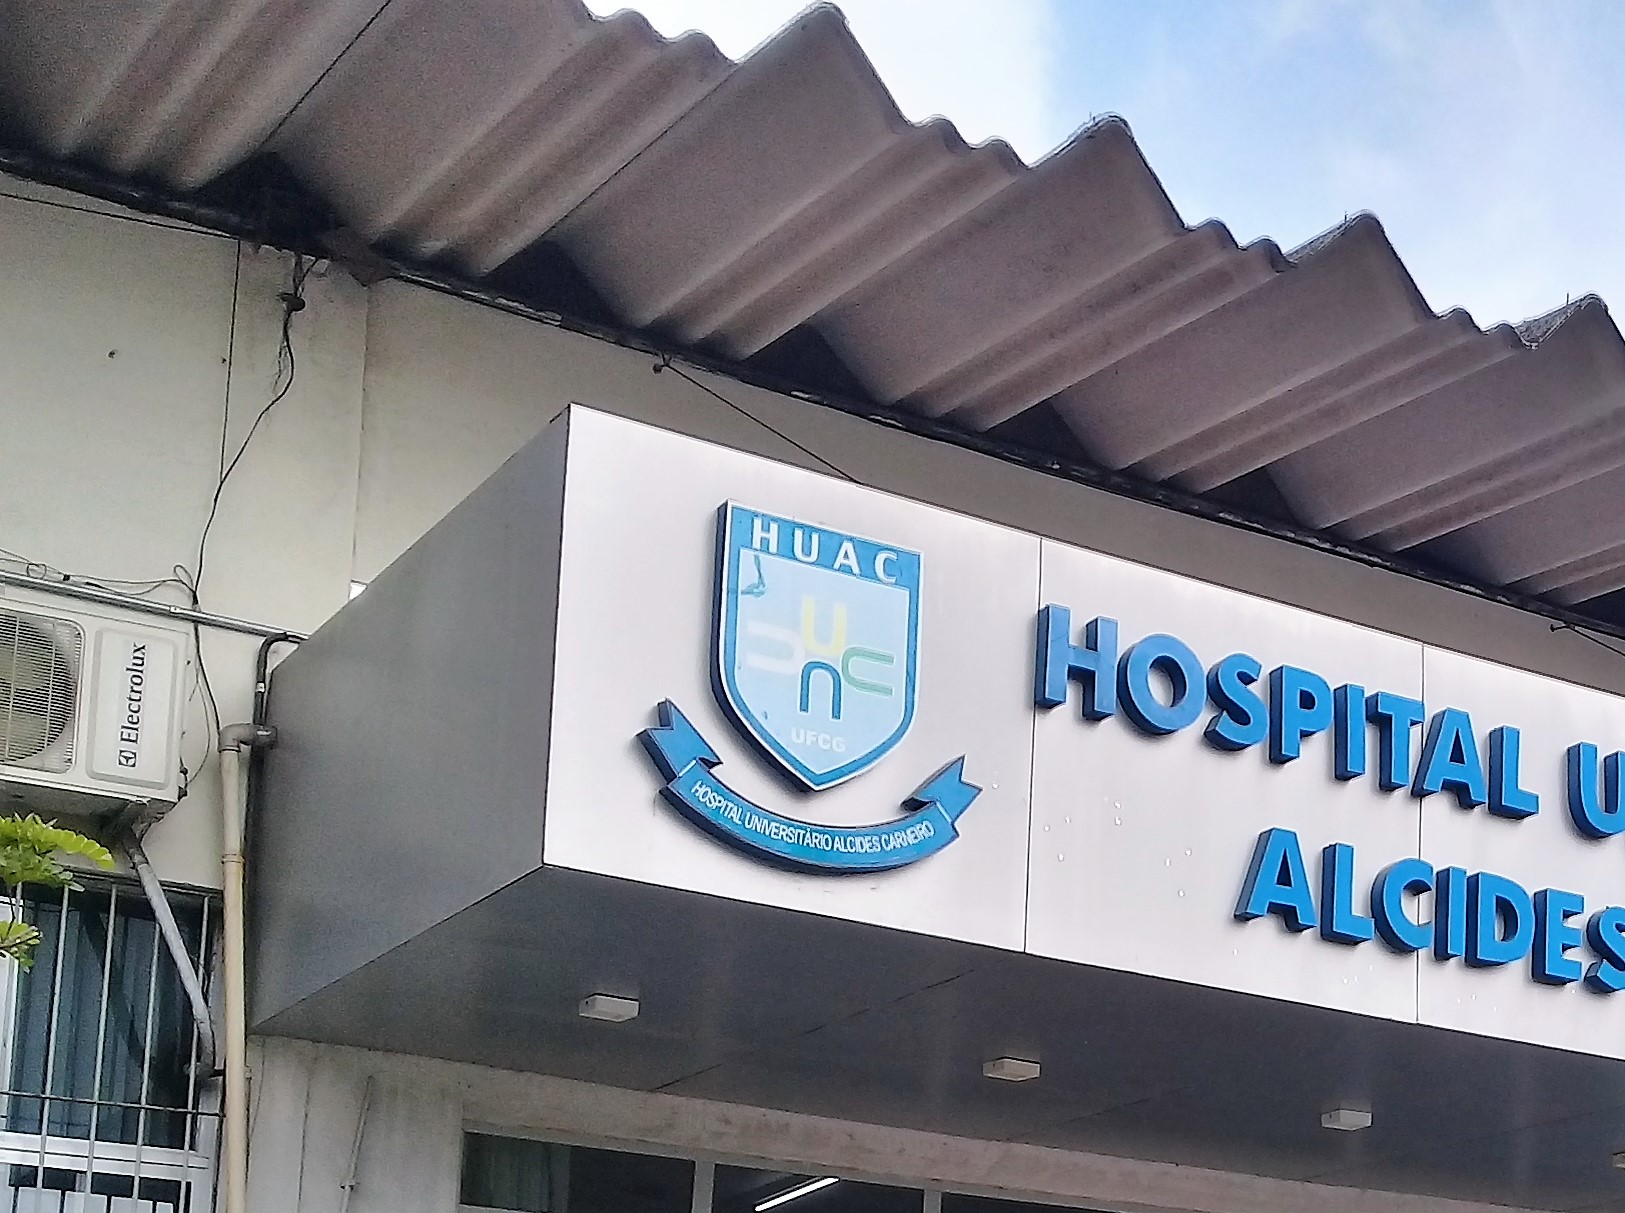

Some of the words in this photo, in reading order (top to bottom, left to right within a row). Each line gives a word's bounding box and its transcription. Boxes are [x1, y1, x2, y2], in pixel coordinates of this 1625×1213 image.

[752, 516, 898, 583] HUAC
[121, 642, 146, 744] Electrolux
[1035, 603, 1539, 820] HOSPITAL
[791, 727, 846, 752] UFCG
[691, 781, 742, 825] HOSPITAL
[745, 811, 832, 851] UNIVERSITÁRIO
[834, 836, 880, 853] ALCIDES
[882, 820, 935, 851] CARNEIRO
